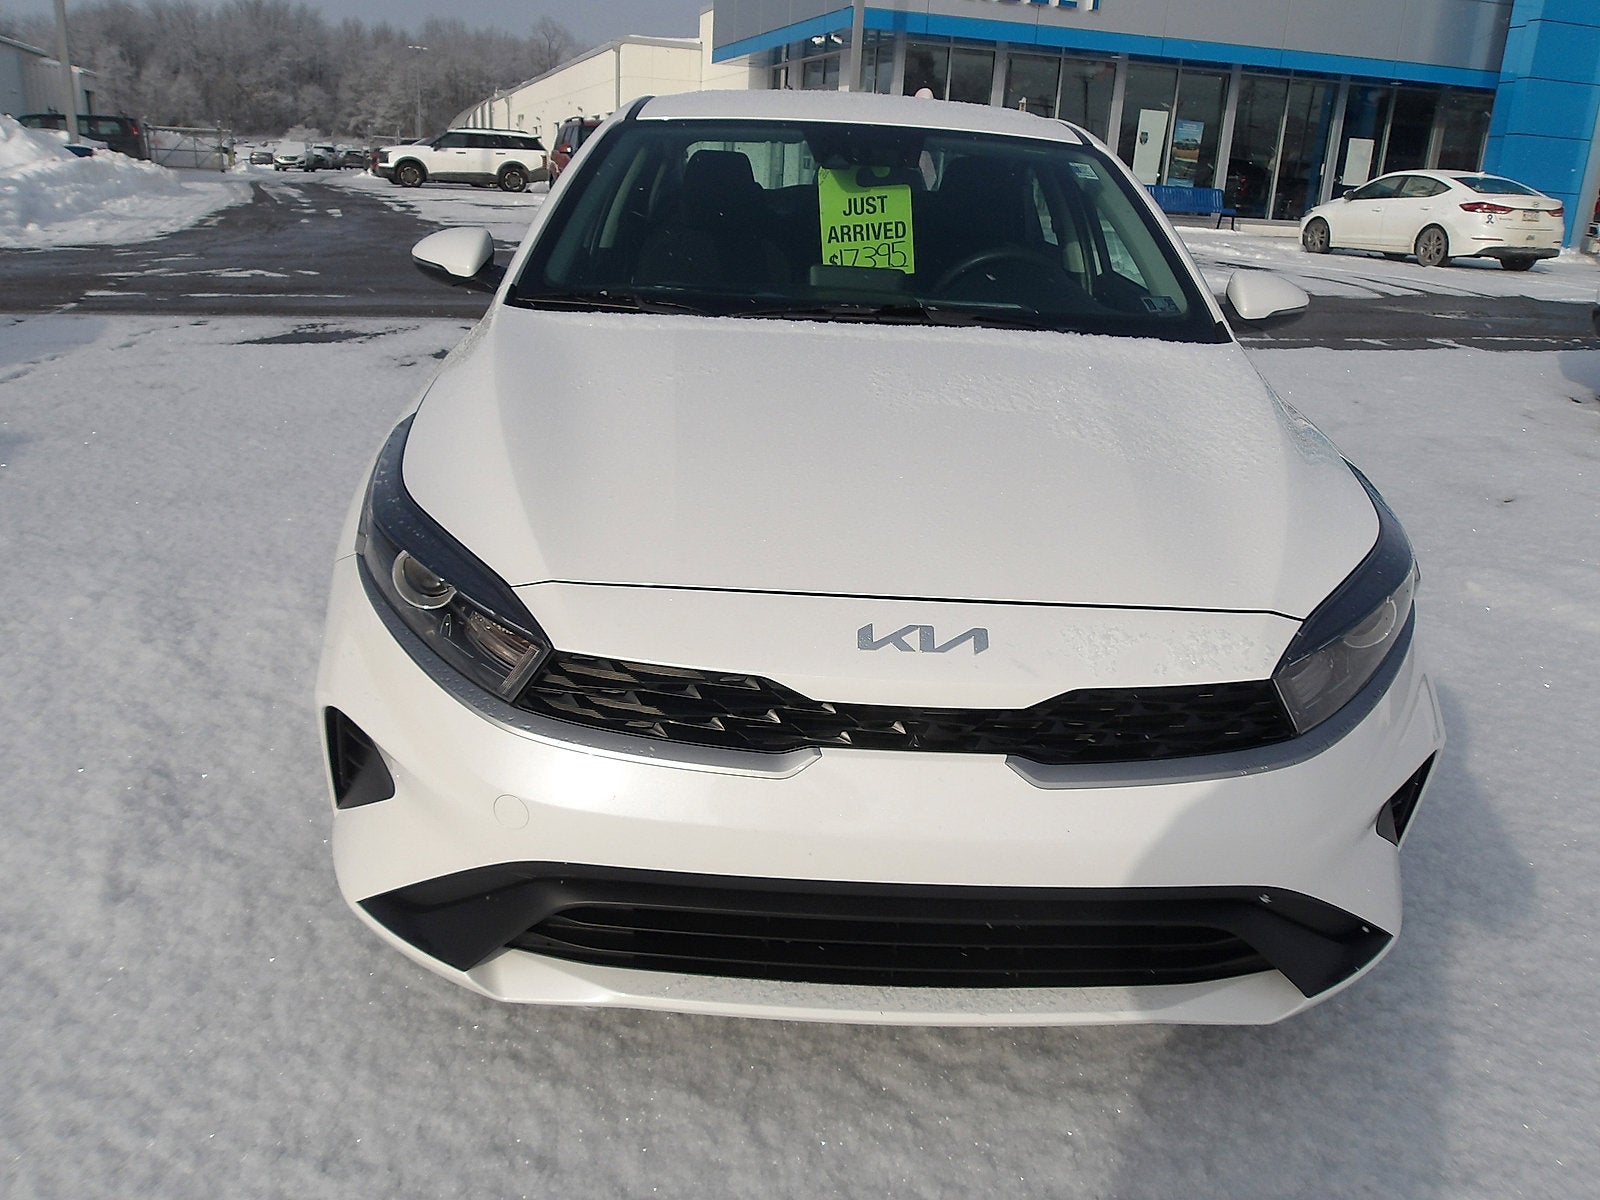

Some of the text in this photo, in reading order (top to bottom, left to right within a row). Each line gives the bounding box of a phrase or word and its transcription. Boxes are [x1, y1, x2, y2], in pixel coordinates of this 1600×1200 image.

[842, 195, 888, 216] JUST
[827, 221, 907, 244] ARRIVED
[857, 623, 989, 655] KIA
